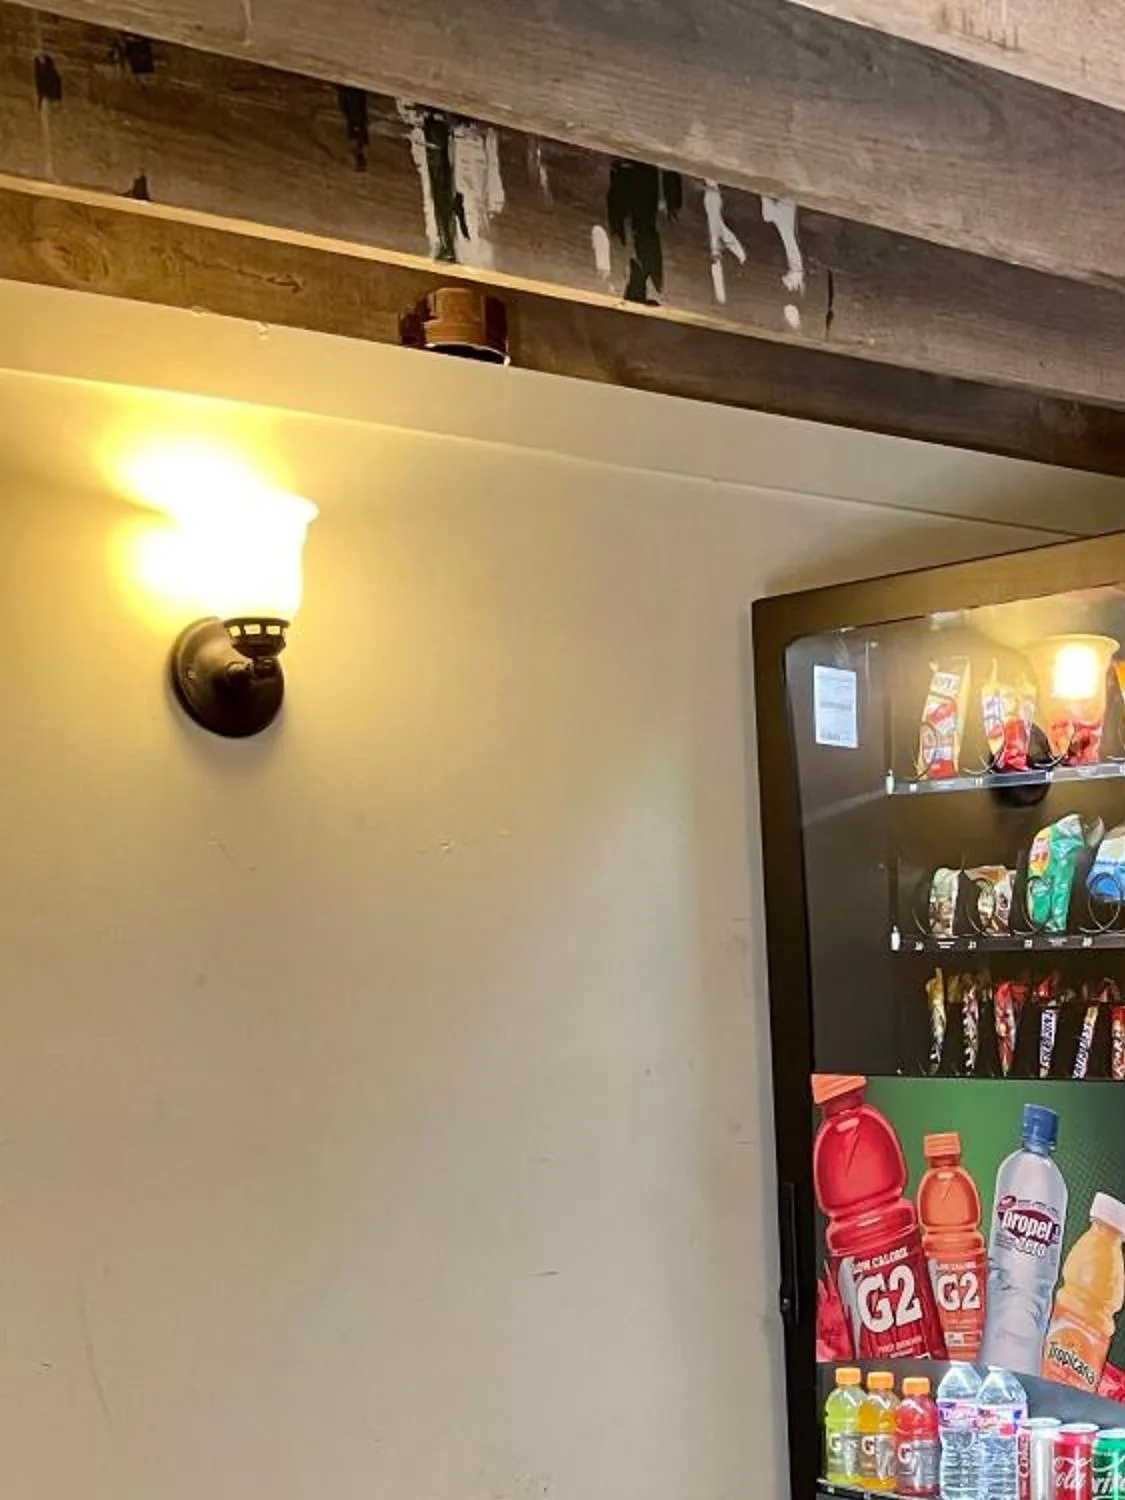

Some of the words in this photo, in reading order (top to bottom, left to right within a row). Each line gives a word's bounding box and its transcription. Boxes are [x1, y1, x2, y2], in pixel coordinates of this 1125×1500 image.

[1001, 1209, 1053, 1241] propel
[858, 1264, 923, 1333] G2
[937, 1271, 982, 1311] G2
[1047, 1341, 1095, 1385] Tropicana
